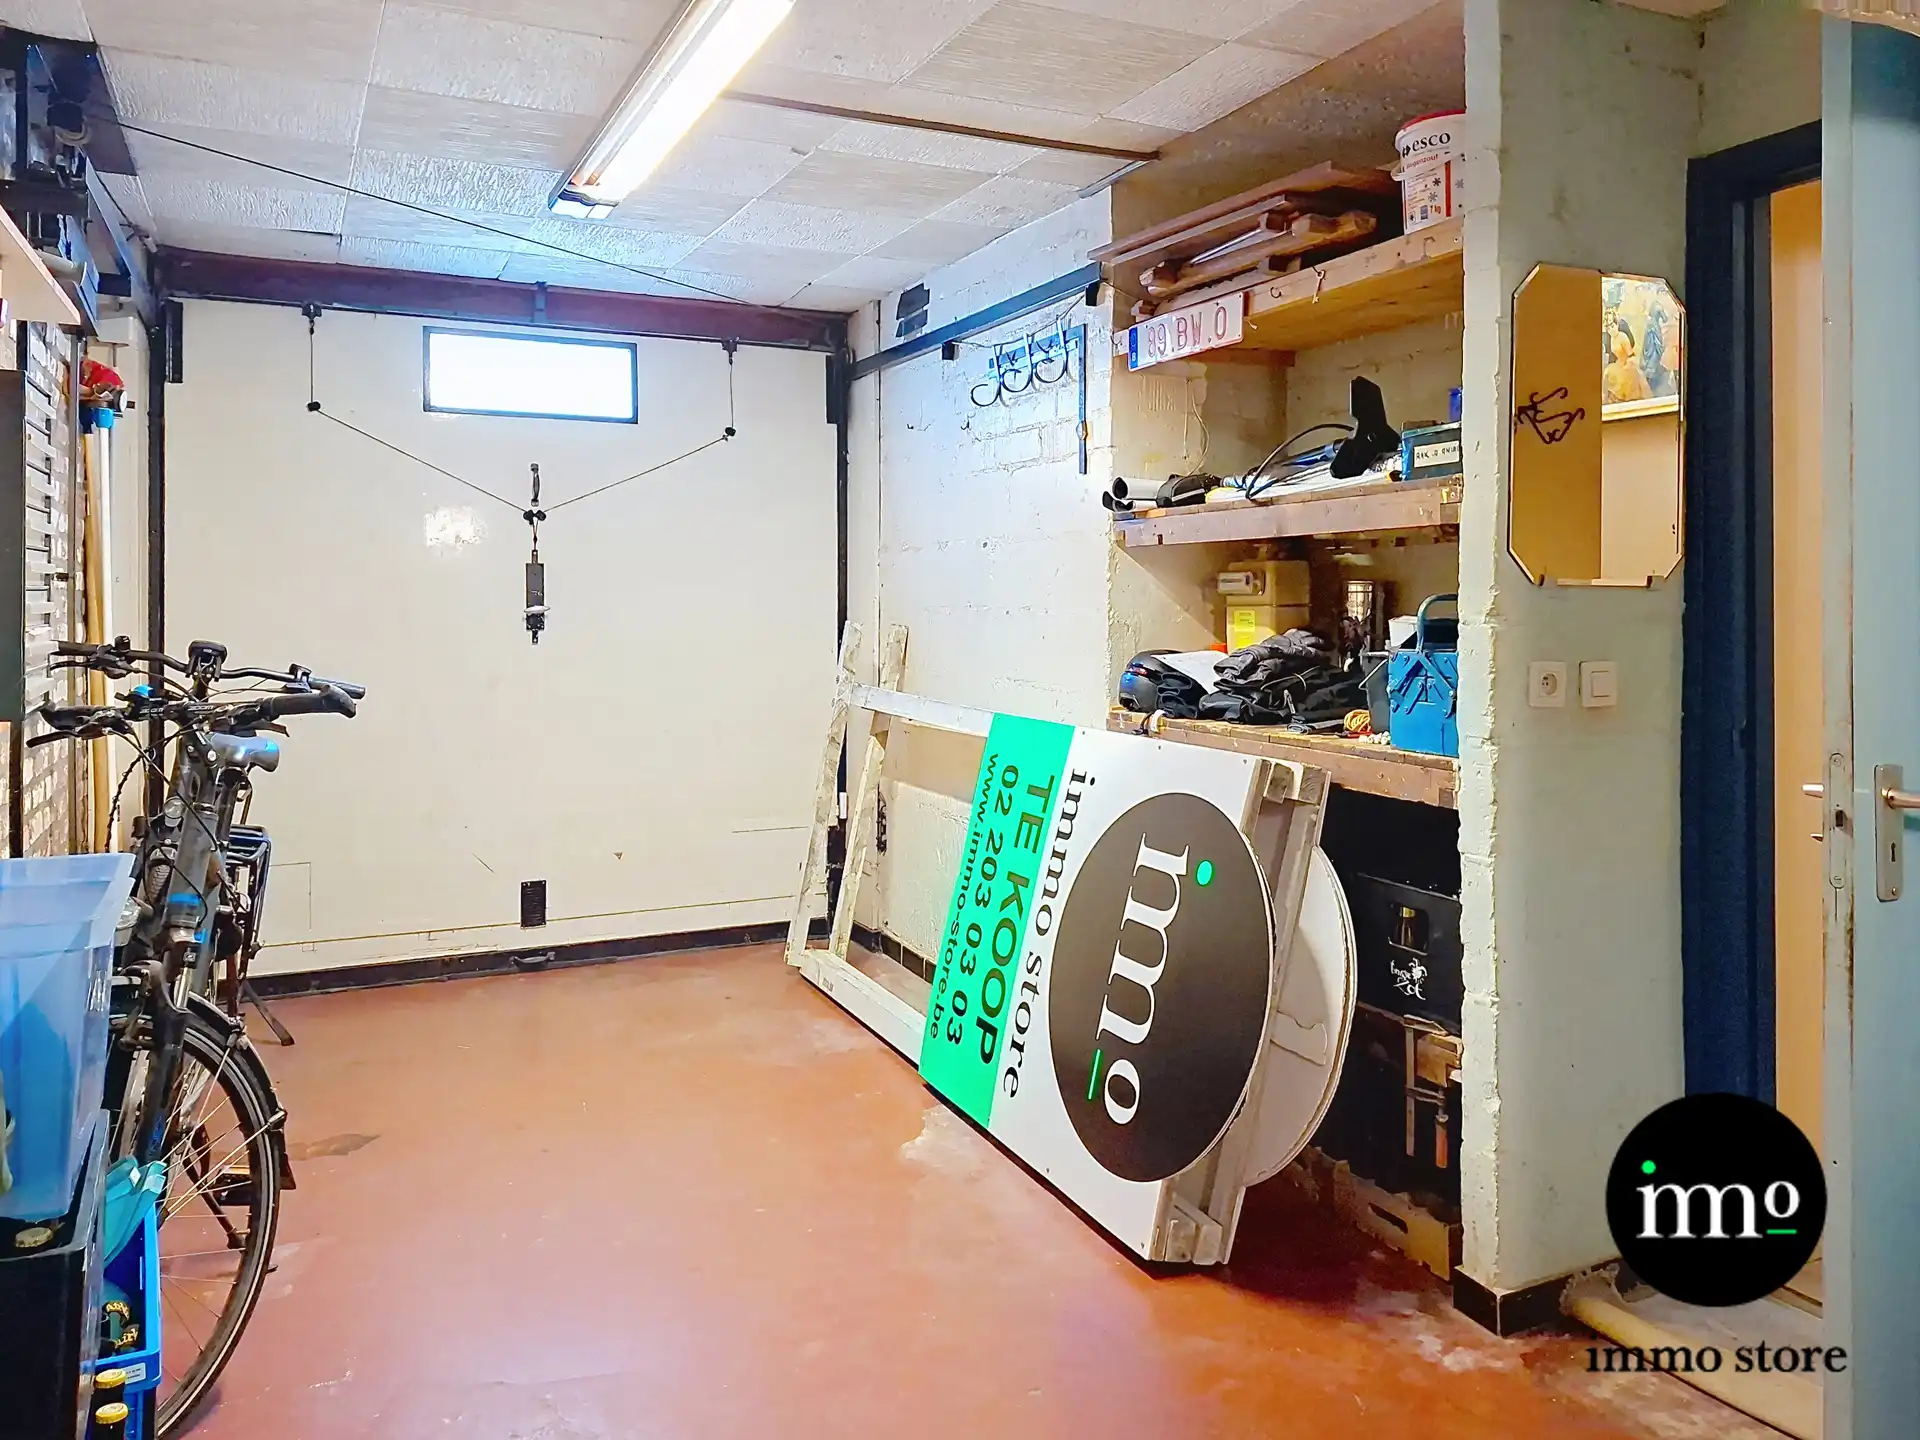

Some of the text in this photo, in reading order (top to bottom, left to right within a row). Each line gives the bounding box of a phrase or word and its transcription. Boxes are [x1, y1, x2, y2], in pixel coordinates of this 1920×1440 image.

[1412, 132, 1451, 152] esco
[930, 753, 999, 1039] www.immo-store.be
[946, 765, 1019, 1045] 02 203 03 03
[976, 774, 1055, 1064] TE KOOP
[1003, 768, 1096, 1098] immo store
